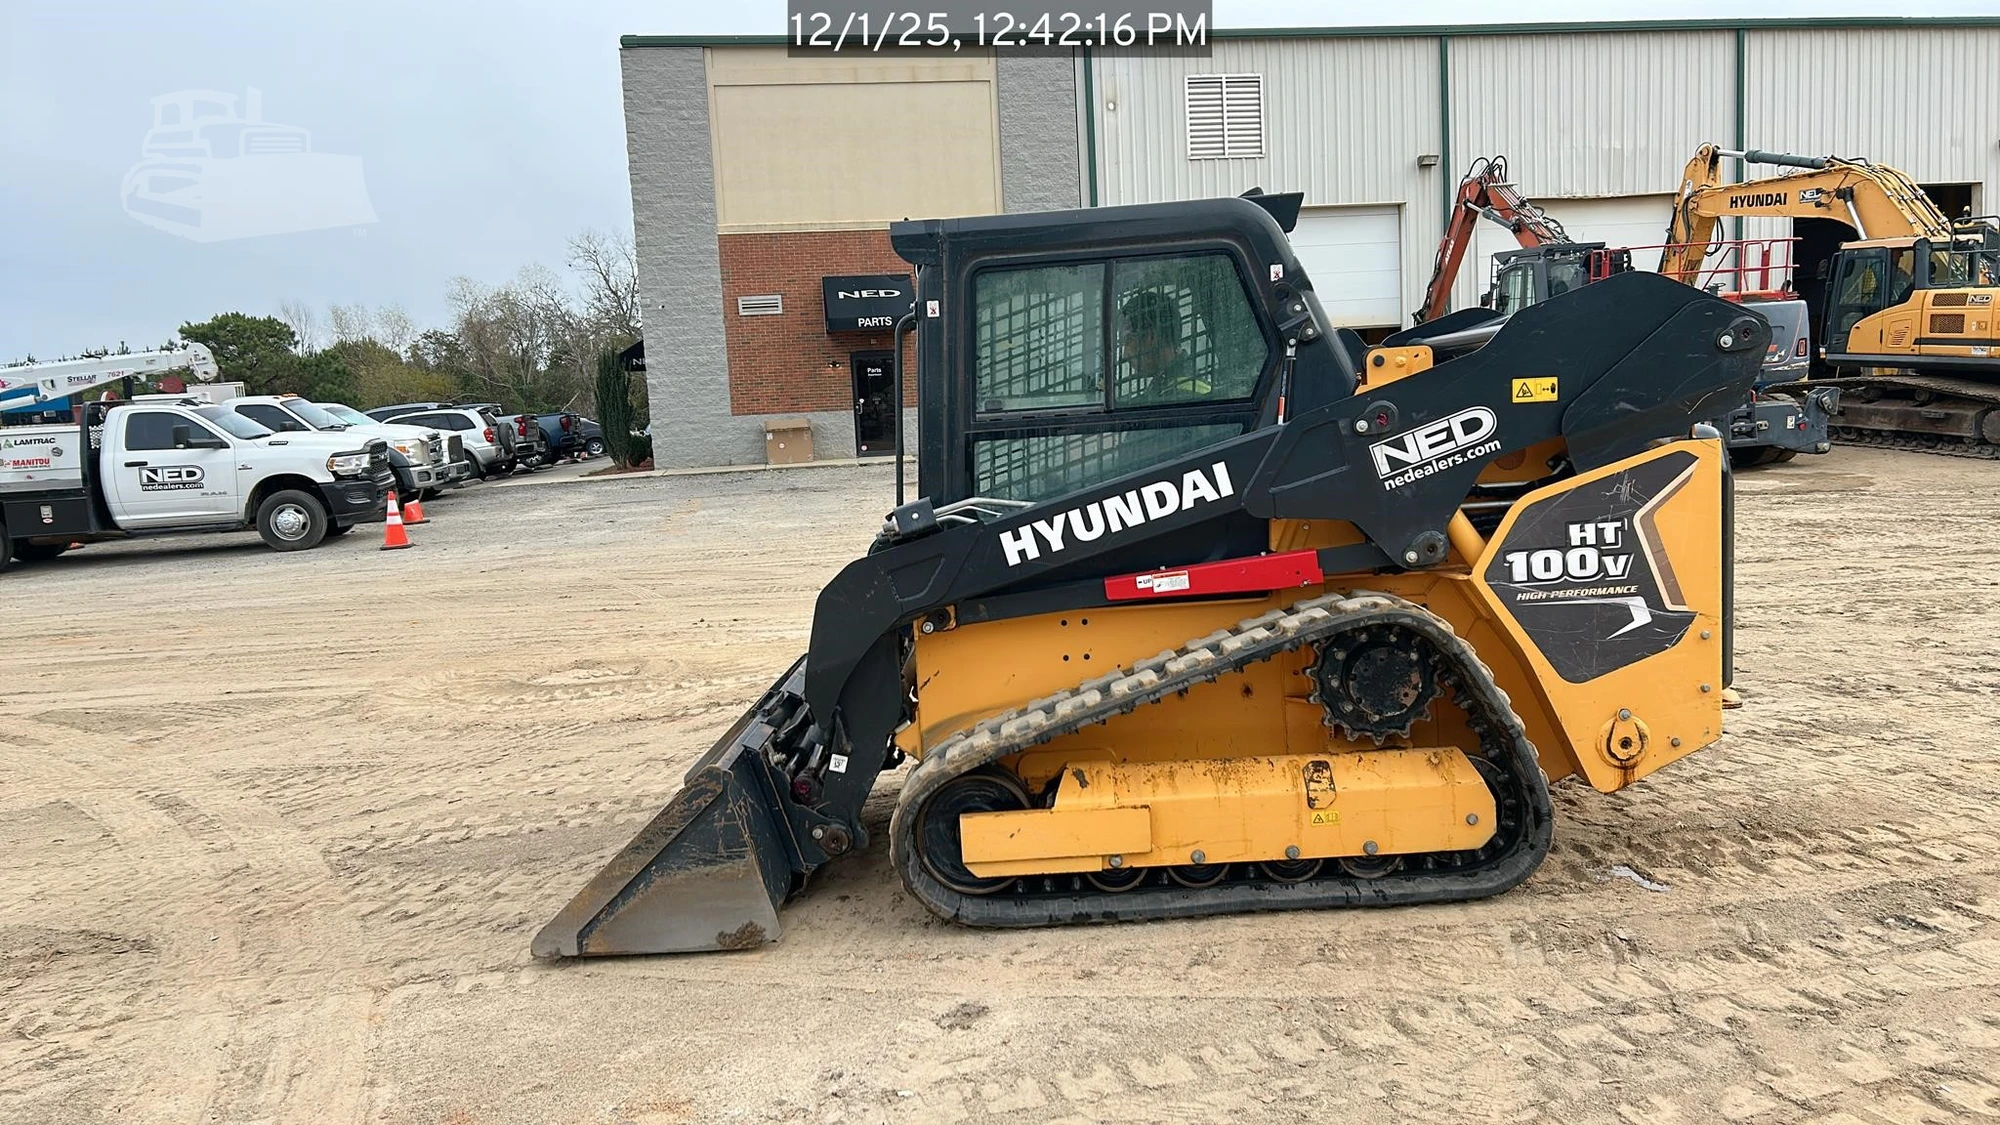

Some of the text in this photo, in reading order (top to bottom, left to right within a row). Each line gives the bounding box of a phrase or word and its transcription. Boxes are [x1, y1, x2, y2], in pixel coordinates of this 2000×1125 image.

[1730, 192, 1788, 208] HYUNDAI
[838, 289, 901, 299] NED
[1969, 295, 1992, 303] NED
[858, 316, 893, 328] PARTS
[14, 437, 56, 446] LAMTRAC
[1372, 409, 1495, 475] NED
[12, 458, 50, 467] MANITOU
[1384, 439, 1502, 491] nedealers.com
[140, 467, 203, 483] NED
[143, 482, 204, 491] nedealers.com
[999, 461, 1235, 567] HYUNDAI
[1568, 521, 1622, 546] HT
[1516, 585, 1639, 601] HIGH PERFORMANCE
